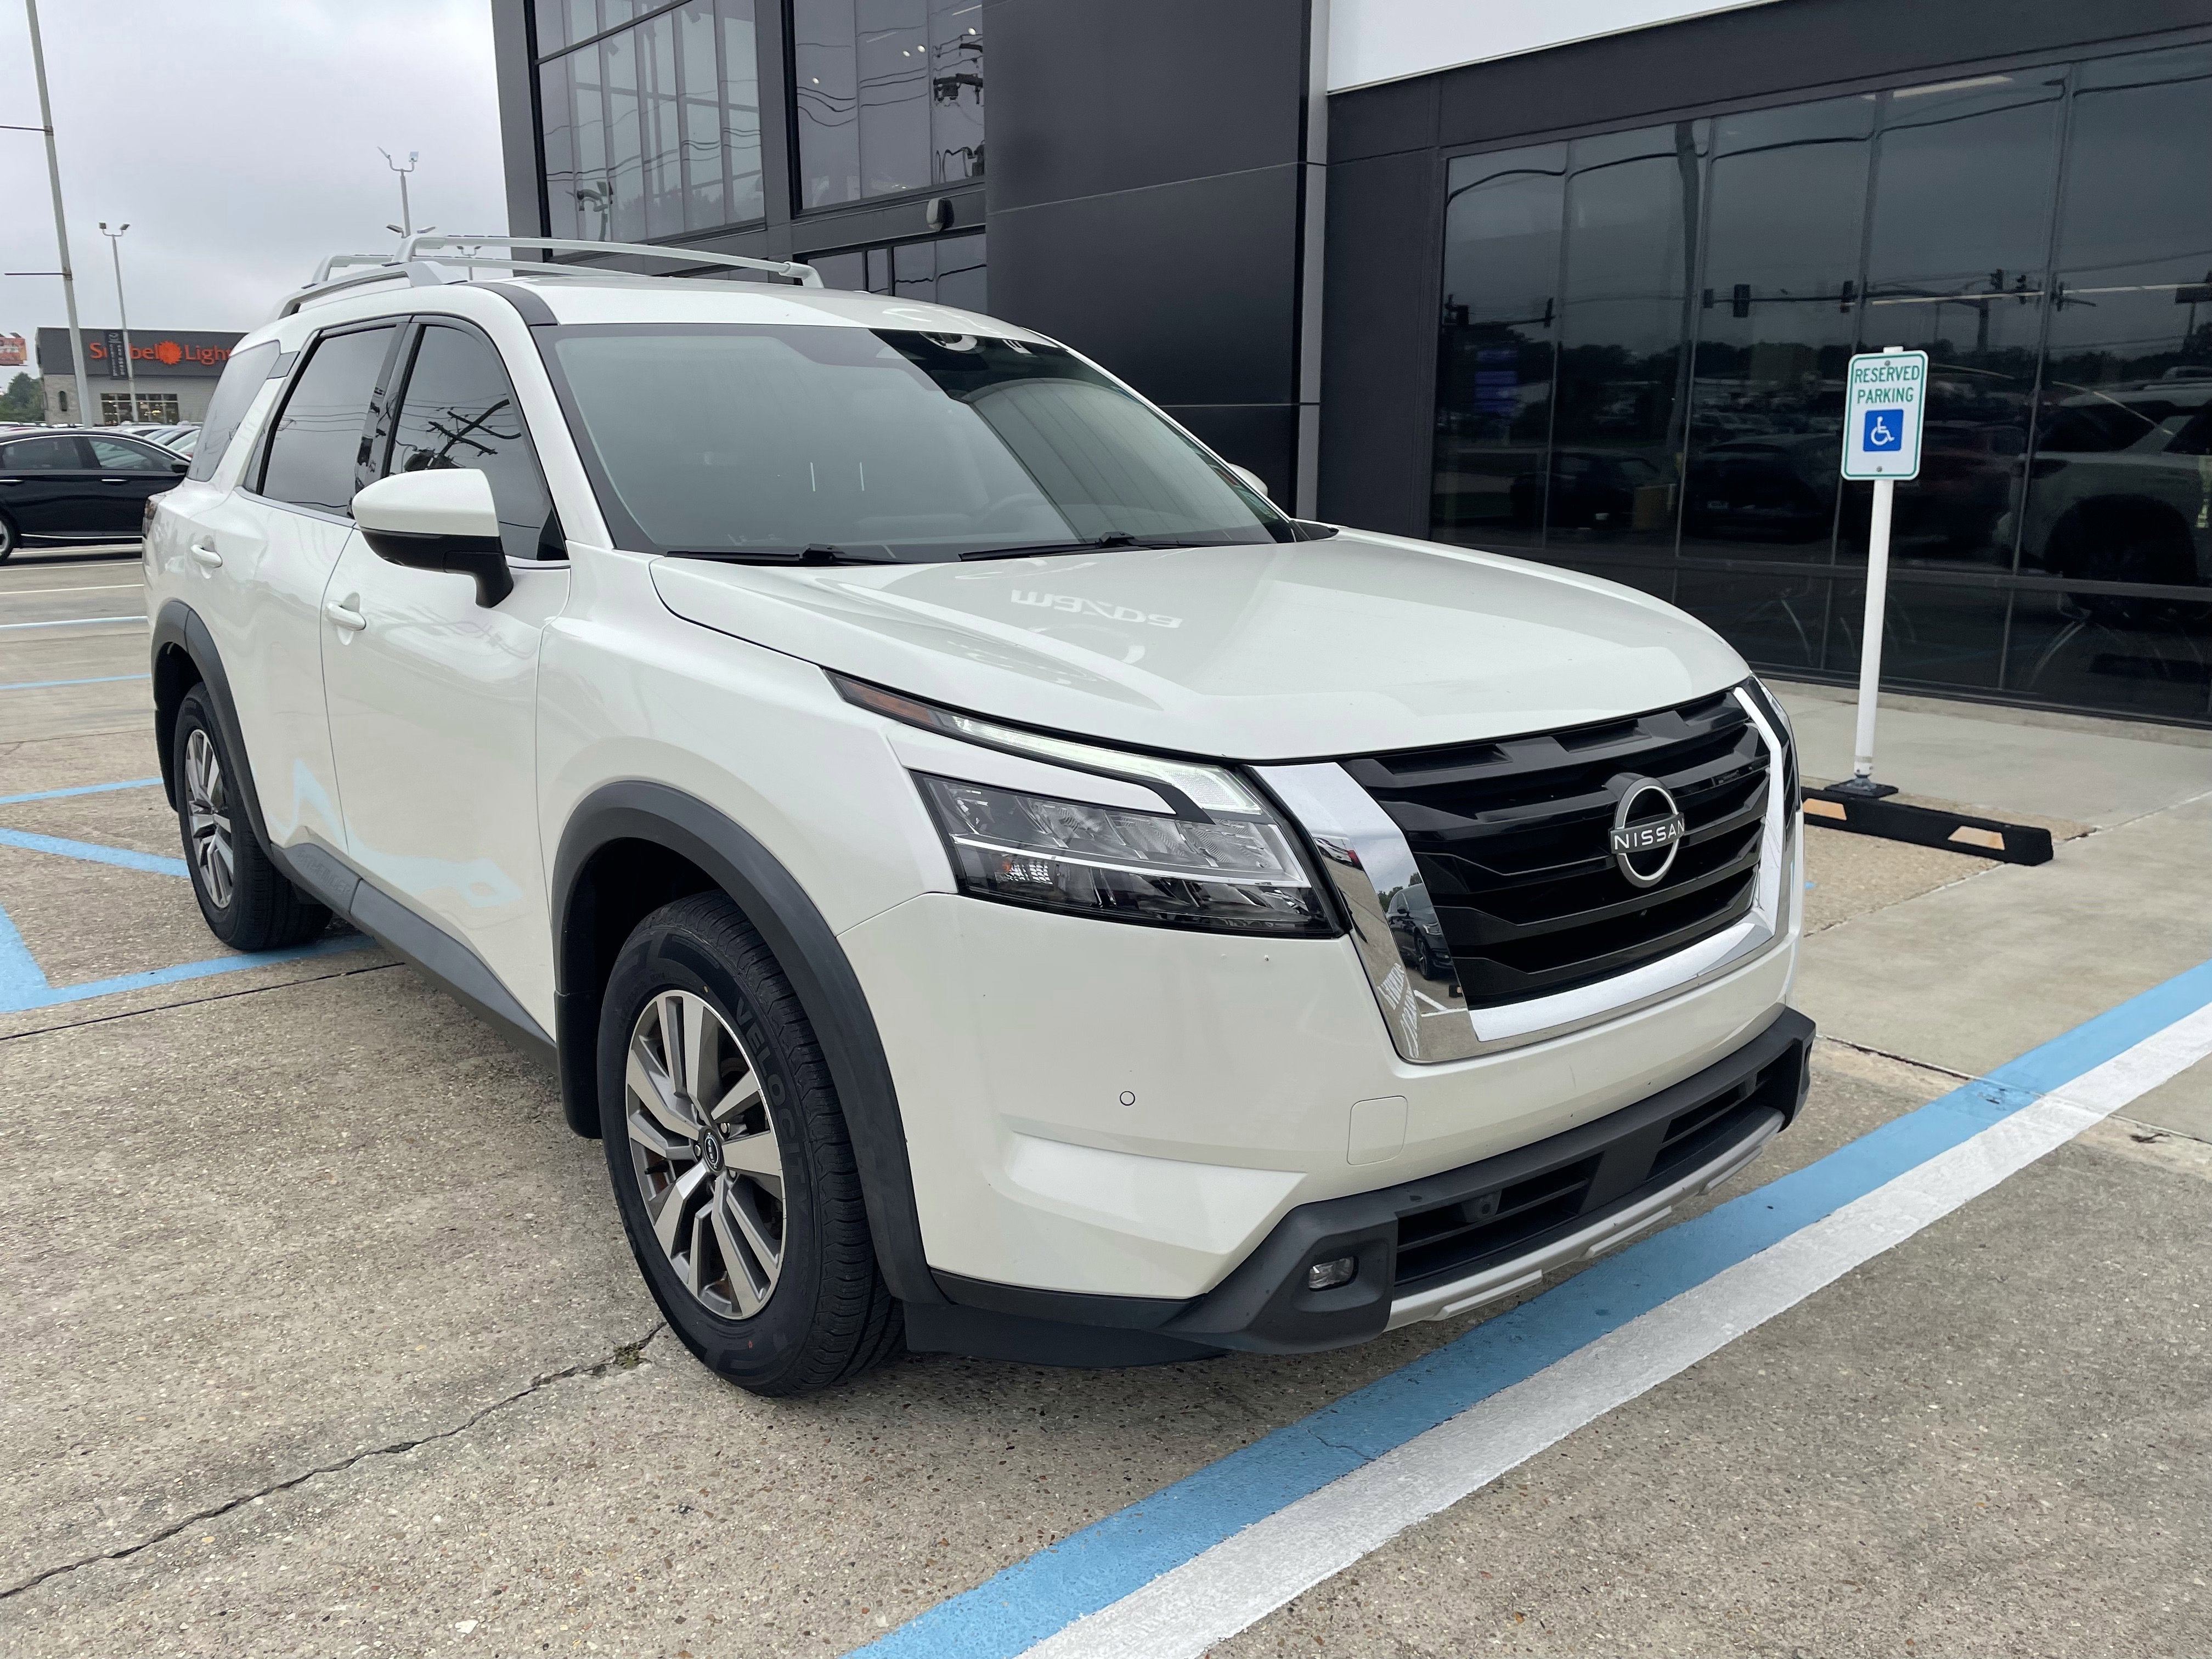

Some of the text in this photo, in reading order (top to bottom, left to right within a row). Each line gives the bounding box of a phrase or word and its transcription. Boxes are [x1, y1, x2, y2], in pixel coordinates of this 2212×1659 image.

[89, 343, 160, 359] Sbel
[1855, 365, 1920, 383] RESERVED
[1857, 387, 1914, 404] PARKING
[1614, 818, 1684, 850] NISSAN
